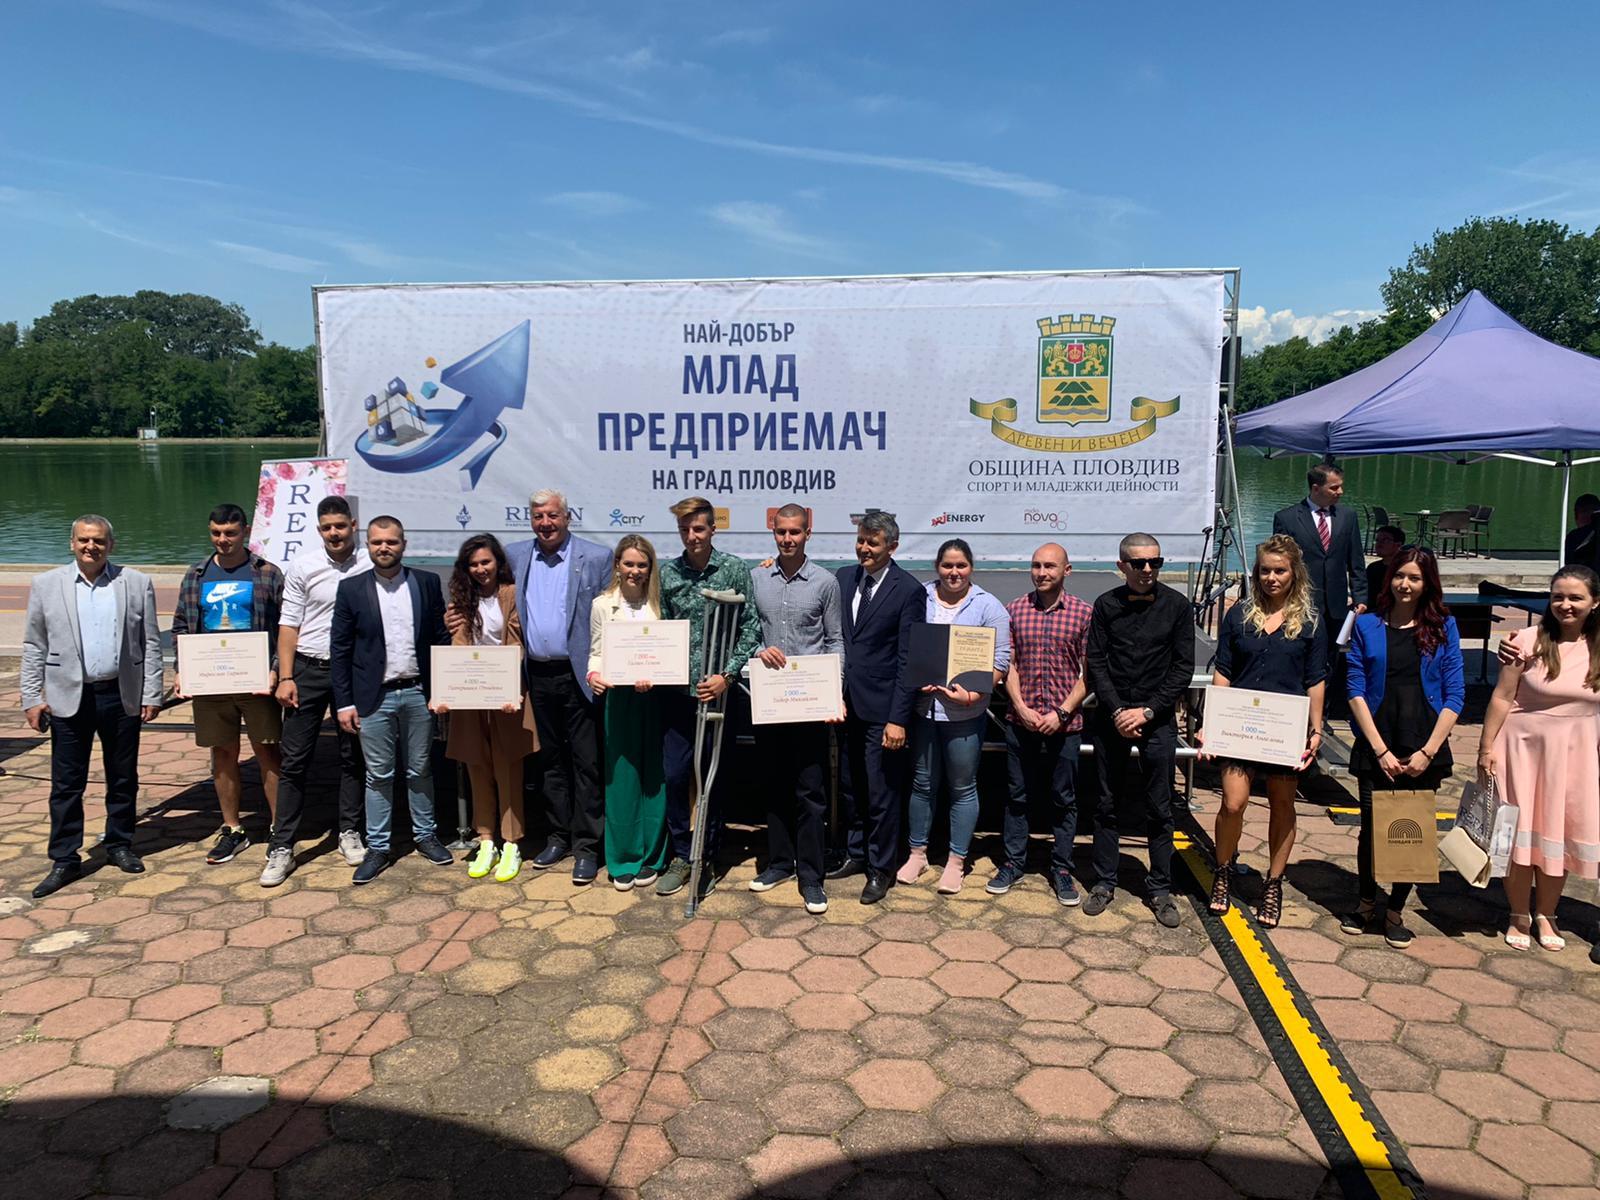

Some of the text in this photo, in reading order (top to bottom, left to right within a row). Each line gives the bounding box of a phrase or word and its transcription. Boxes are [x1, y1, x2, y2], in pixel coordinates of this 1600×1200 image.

[683, 320, 795, 346] НАЙ-ДОБЪР
[682, 354, 799, 402] МЛАД
[597, 411, 887, 459] ПРЕДПРИЕМАЧ
[1004, 429, 1142, 451] ДРЕВЕН И ВЕЧЕН
[968, 458, 1181, 477] ОБЩИНА ПЛОВДИВ
[652, 470, 836, 494] НА ГРАД ПЛОВДИВ
[967, 479, 1179, 493] СПОРТ И МЛАДЕЖКИ ДЕЙНОСТИ
[947, 514, 986, 523] ENERGY
[211, 602, 238, 611] AR
